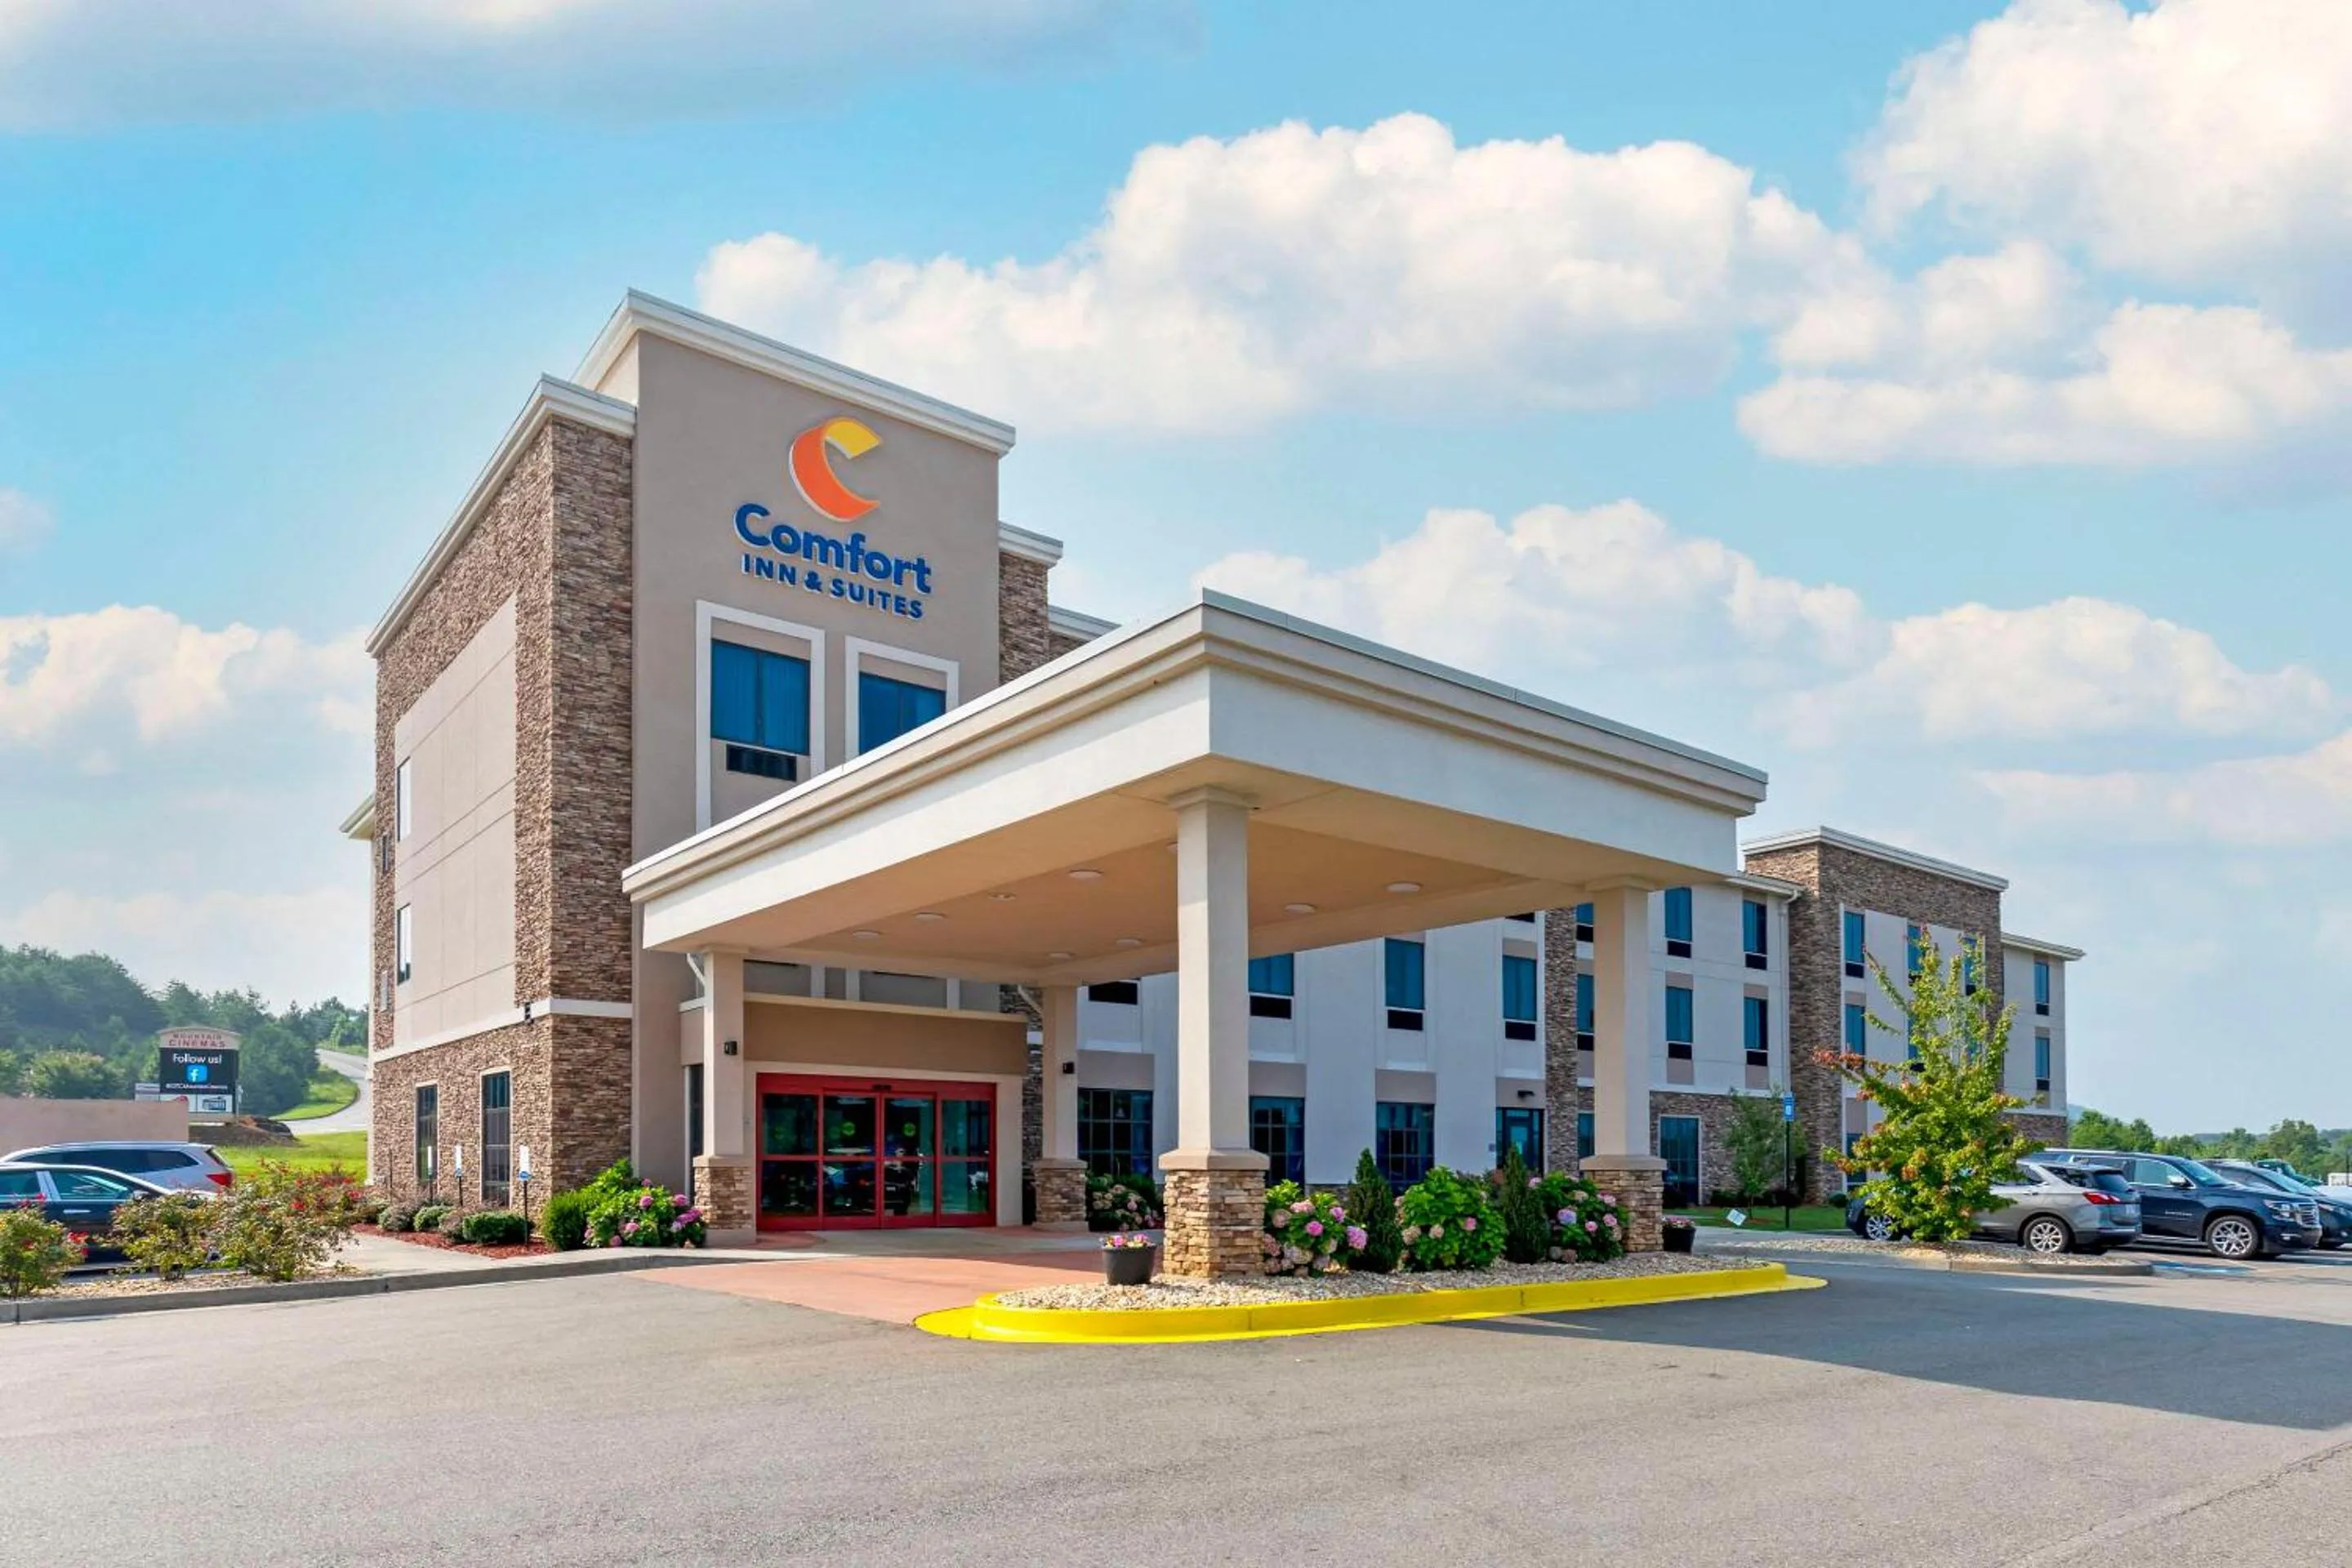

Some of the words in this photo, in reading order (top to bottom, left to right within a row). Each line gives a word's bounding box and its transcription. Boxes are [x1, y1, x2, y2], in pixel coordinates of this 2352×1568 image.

[734, 502, 932, 595] Comfort
[742, 553, 797, 586] INN
[803, 570, 822, 593] &
[830, 577, 924, 621] SUITES
[172, 1053, 206, 1063] Follow
[207, 1054, 222, 1064] us!
